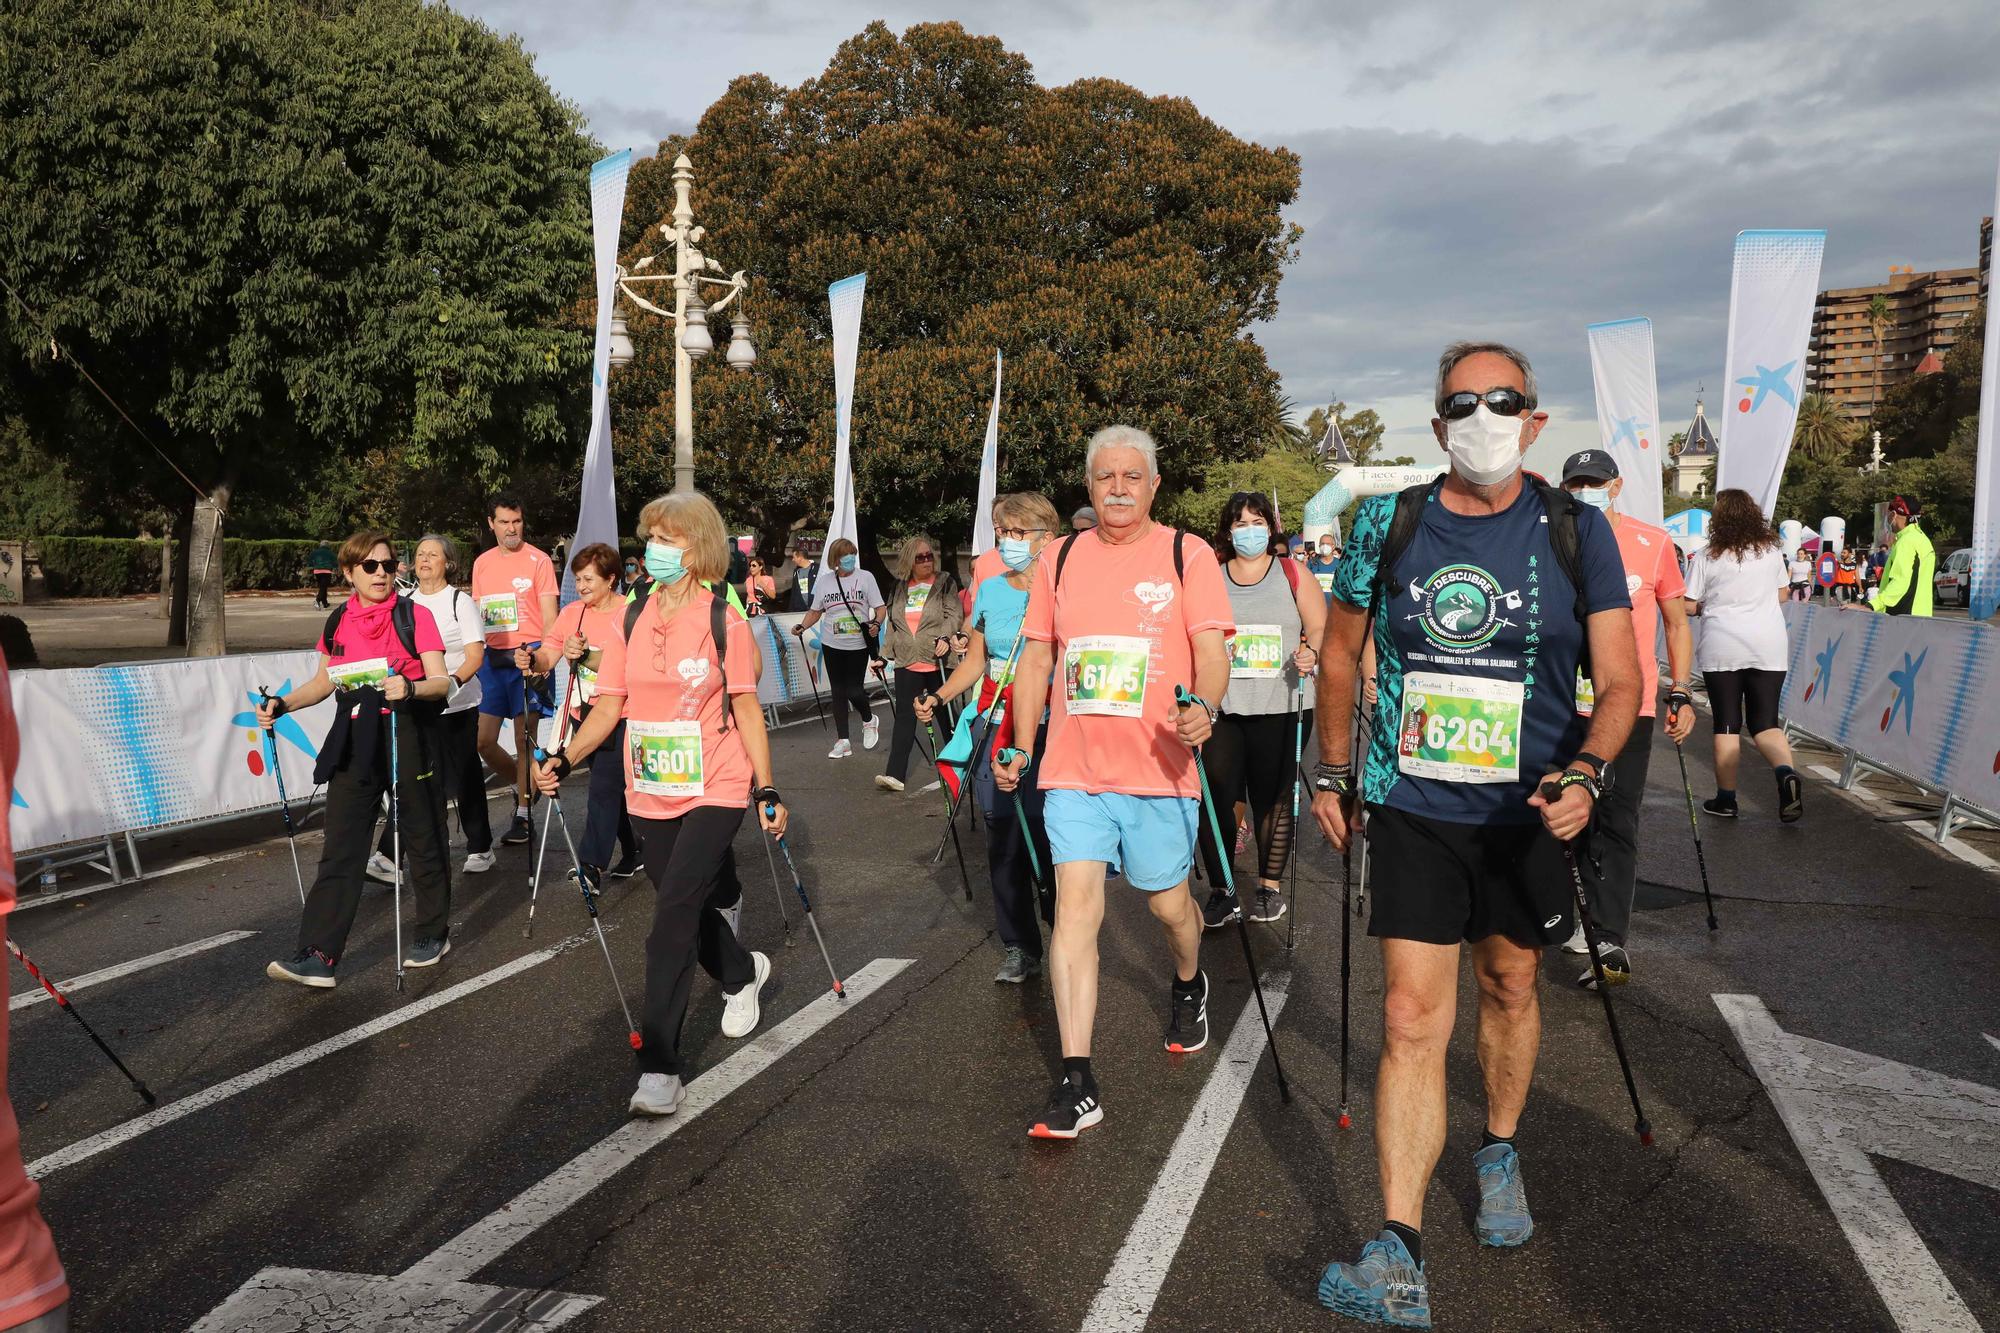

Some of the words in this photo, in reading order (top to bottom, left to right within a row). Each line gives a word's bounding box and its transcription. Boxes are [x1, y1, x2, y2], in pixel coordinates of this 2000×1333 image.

[1371, 471, 1397, 479] aecc
[1403, 474, 1422, 483] 900
[1433, 571, 1493, 594] DESCUBRE
[1425, 592, 1434, 609] CLUB
[1426, 609, 1432, 617] DE
[1428, 617, 1461, 640] SENDERISMO
[1466, 622, 1491, 640] MARCHA
[1425, 637, 1492, 655] #turianordicwalking
[1434, 655, 1464, 665] NATURALEZA
[1464, 657, 1471, 666] DE
[1472, 658, 1489, 667] FORMA
[1490, 659, 1518, 669] SALUDABLE
[1083, 664, 1139, 693] 6145
[1427, 714, 1513, 756] 6264
[646, 749, 695, 775] 5601
